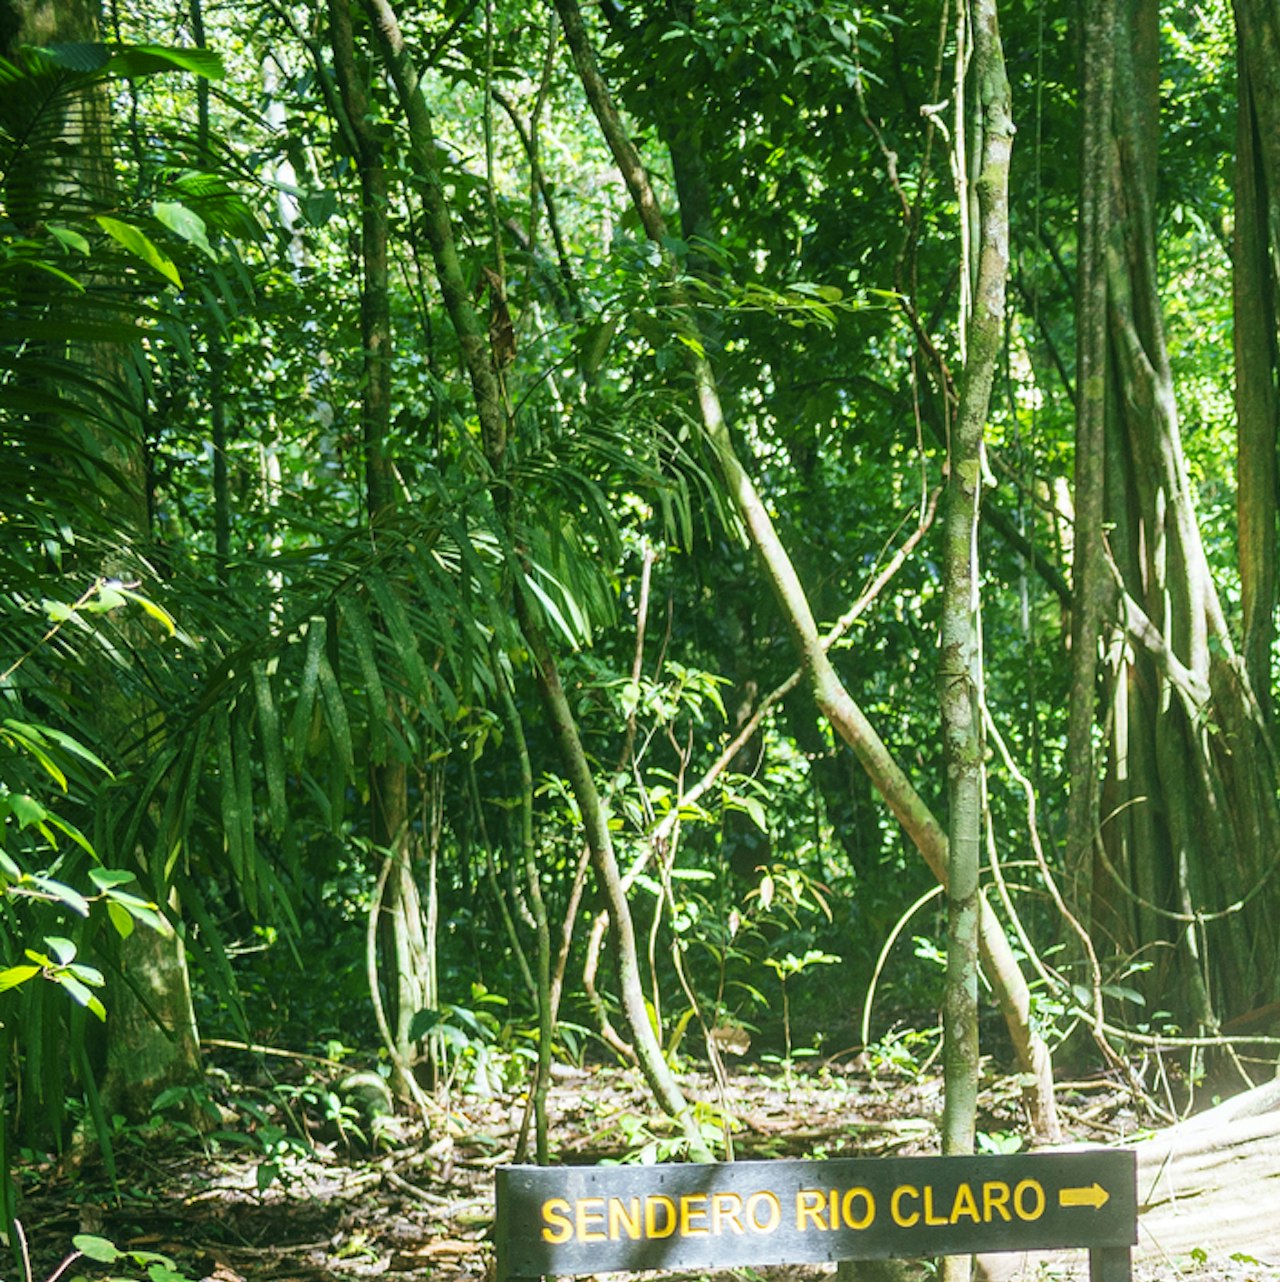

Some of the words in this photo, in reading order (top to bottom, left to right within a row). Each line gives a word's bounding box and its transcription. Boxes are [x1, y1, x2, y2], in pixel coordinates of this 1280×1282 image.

[541, 1190, 781, 1245] SENDERO
[796, 1186, 877, 1232] RIO
[890, 1179, 1047, 1228] CLARO
